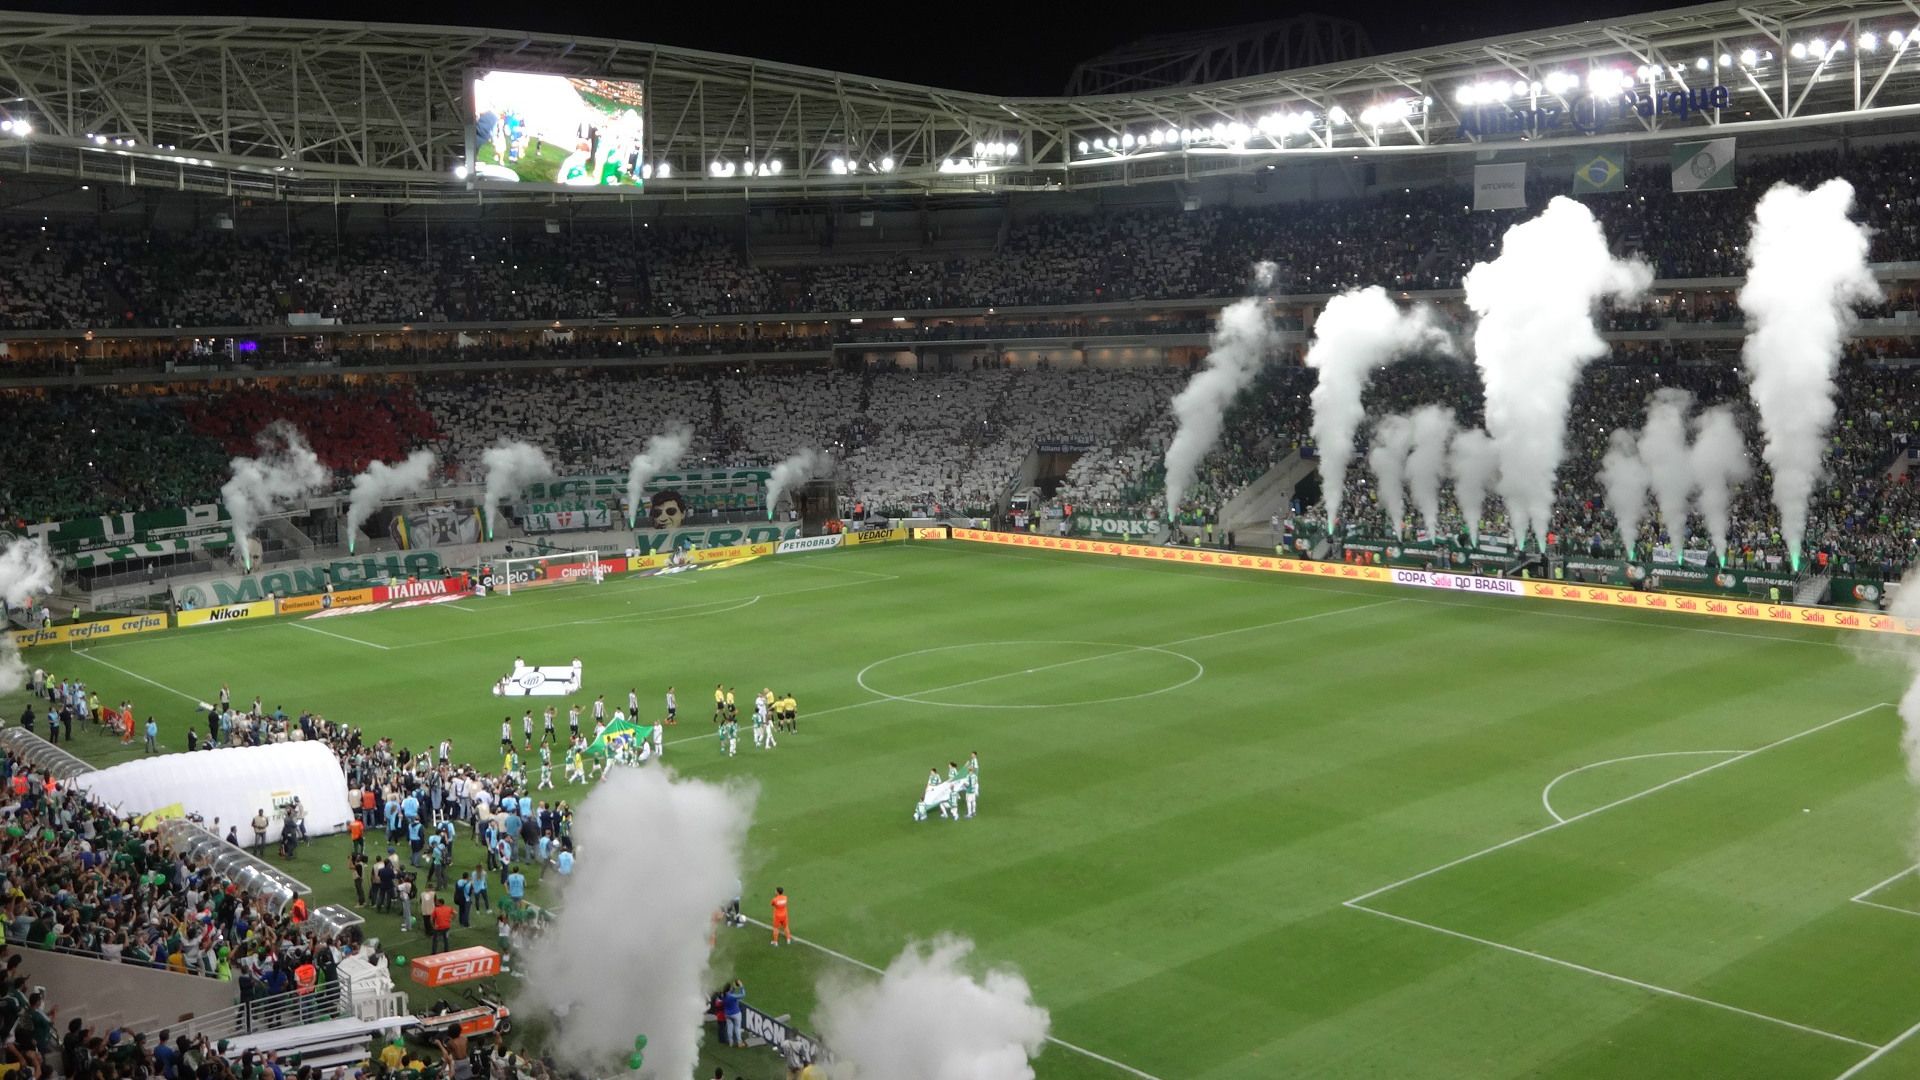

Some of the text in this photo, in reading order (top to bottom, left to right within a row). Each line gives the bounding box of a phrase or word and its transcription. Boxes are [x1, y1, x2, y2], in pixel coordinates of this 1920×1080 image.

[1619, 85, 1730, 122] Parque
[1091, 517, 1160, 534] PORK'S
[858, 529, 894, 540] VEDACIT
[921, 528, 941, 539] Sadia
[751, 545, 767, 554] Sadia
[784, 537, 837, 550] PETROBRAS
[637, 558, 655, 568] Sadia
[1397, 571, 1427, 584] COPA
[1430, 572, 1452, 587] Sadia
[1475, 579, 1515, 592] BRASIL
[387, 579, 447, 600] ITAIPAVA
[1534, 584, 1553, 596] Sadia
[1561, 586, 1580, 598] Sadia
[1588, 589, 1608, 601] Sadia
[1617, 592, 1637, 604] Sadia
[1646, 594, 1666, 607] Sadia
[1675, 598, 1696, 610] Sadia
[1706, 600, 1727, 614] Sadia
[1736, 604, 1758, 616] Sadia
[1768, 606, 1791, 620] Sadia
[1801, 610, 1824, 623] Sadia
[1834, 613, 1859, 626] Sadia
[210, 608, 249, 621] Nikon
[15, 615, 161, 646] crefisa crefisa crefisa
